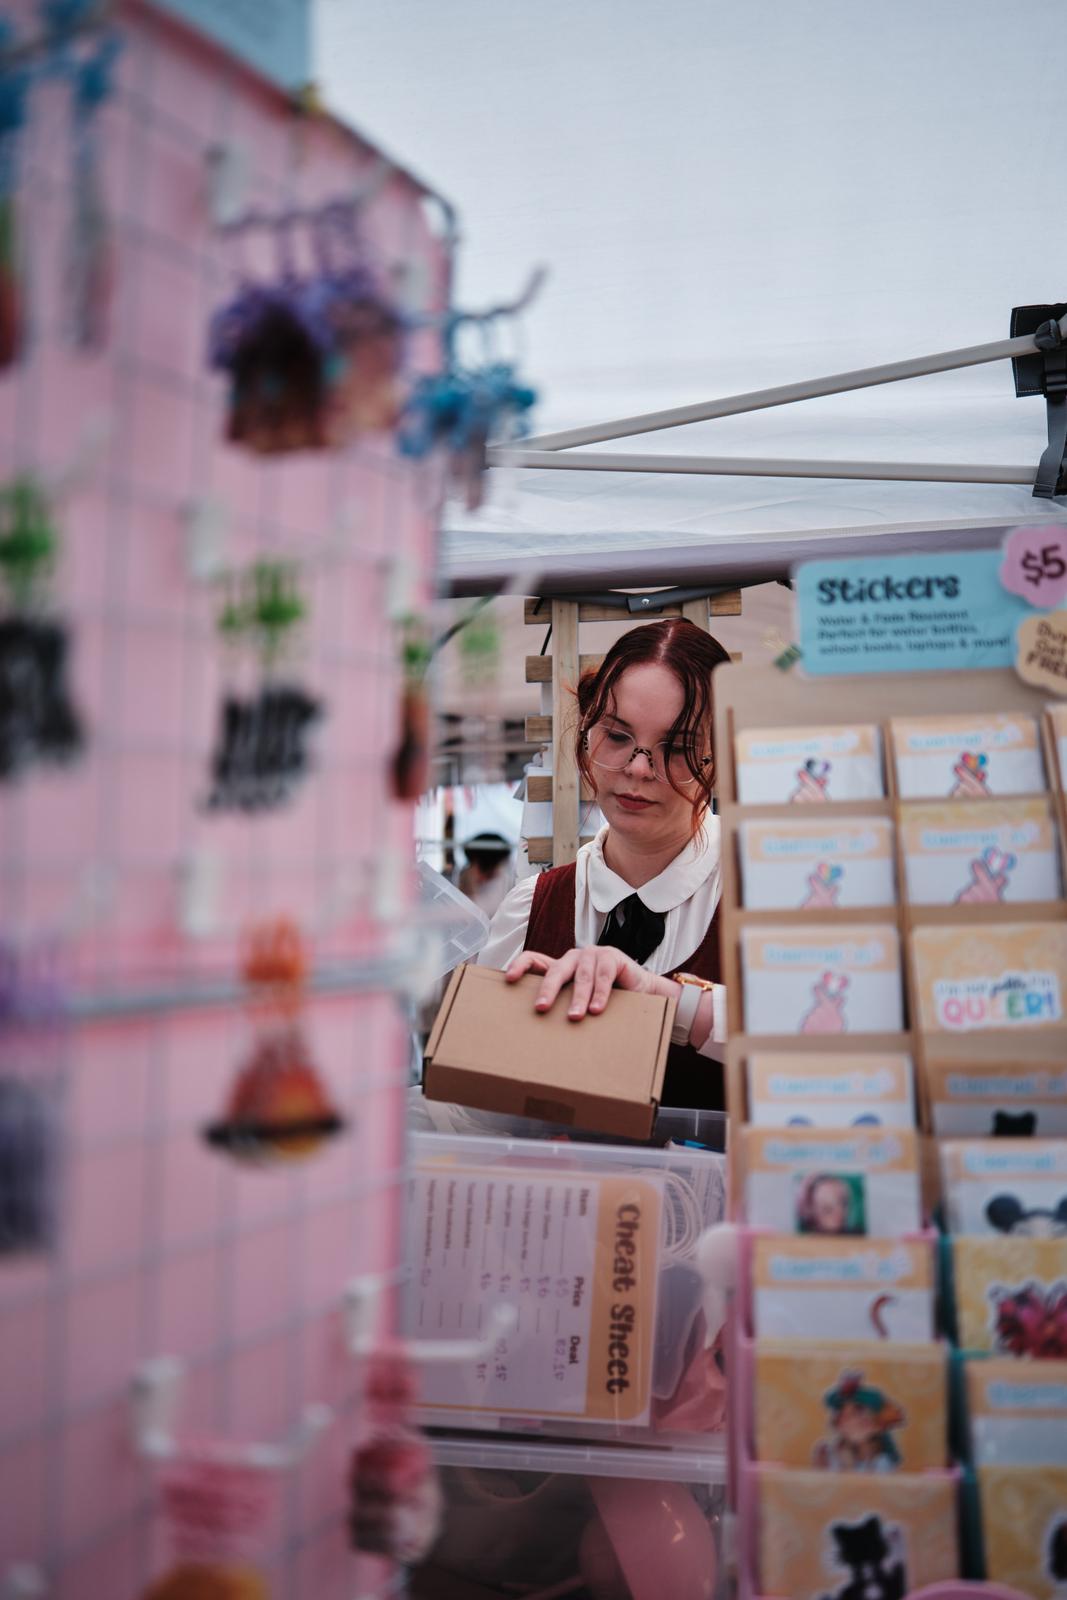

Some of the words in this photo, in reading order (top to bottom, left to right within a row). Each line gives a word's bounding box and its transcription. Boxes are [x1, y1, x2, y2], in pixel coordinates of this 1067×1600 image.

[1021, 544, 1067, 587] $5
[817, 574, 961, 605] Stickers
[892, 625, 928, 637] water
[579, 1188, 590, 1217] Item
[612, 1203, 641, 1293] Cheat
[571, 1276, 585, 1307] Price
[568, 1335, 581, 1365] Deal
[605, 1303, 636, 1395] Sheet
